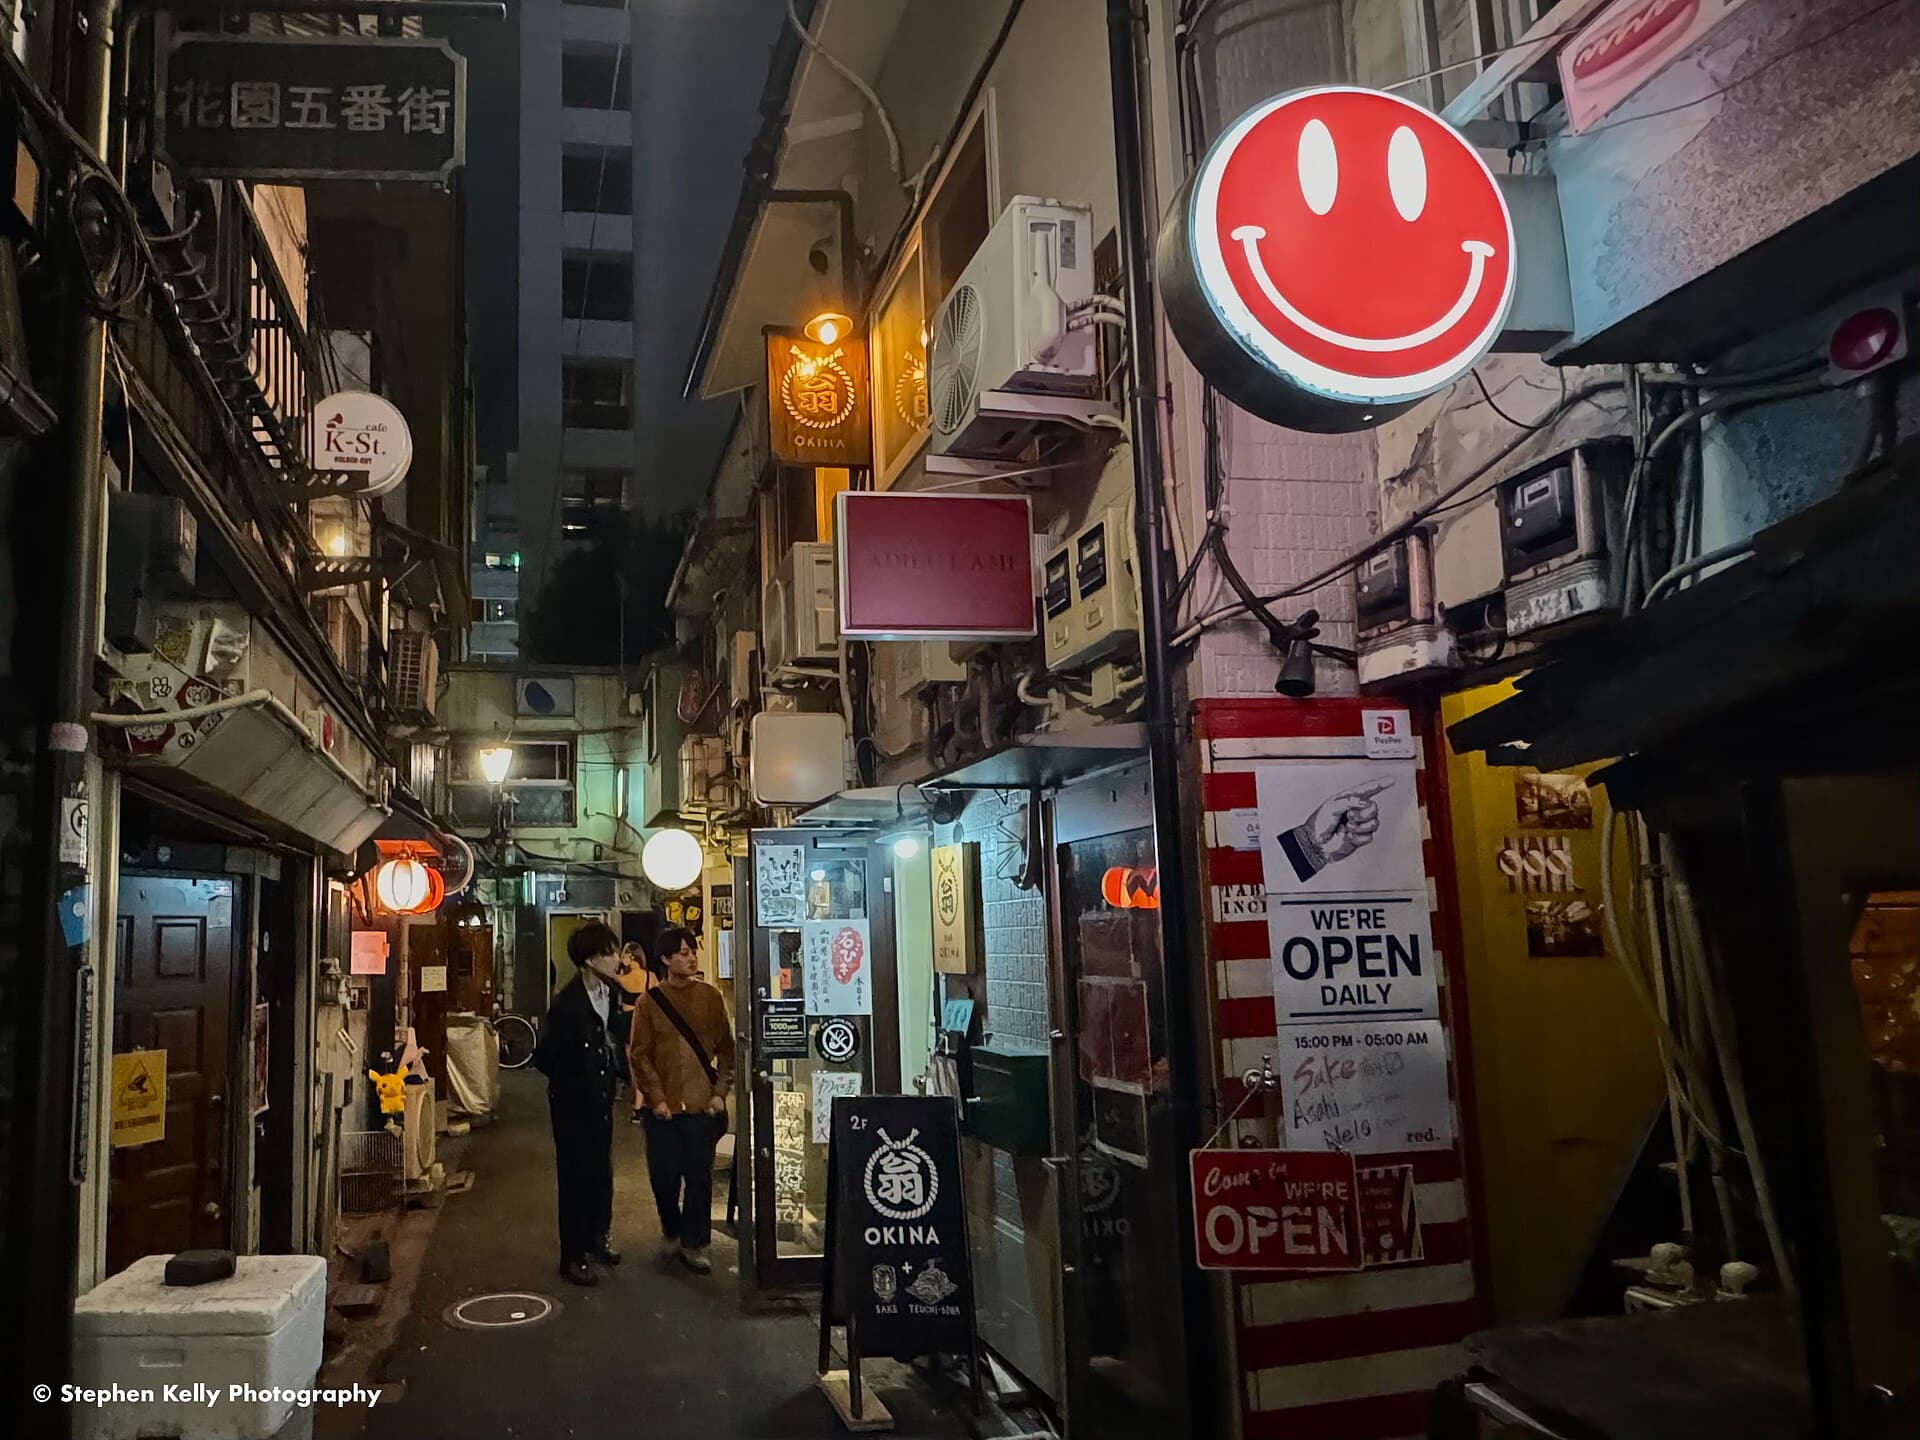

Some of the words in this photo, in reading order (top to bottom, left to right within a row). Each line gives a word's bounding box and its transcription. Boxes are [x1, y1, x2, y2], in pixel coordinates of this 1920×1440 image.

[173, 79, 451, 135] 花園五番街
[324, 430, 386, 455] K-St.
[1311, 909, 1386, 930] WE'RE
[1283, 934, 1421, 980] OPEN
[1321, 983, 1391, 1006] DAILY
[1294, 1035, 1329, 1048] 15:00
[1333, 1035, 1353, 1047] PM
[1365, 1033, 1403, 1047] 05:00
[1407, 1032, 1428, 1045] AM
[850, 1115, 868, 1130] 2F
[1406, 1128, 1440, 1143] red.
[877, 1151, 923, 1205] 翁
[864, 1225, 940, 1245] OKINA
[1205, 1204, 1349, 1255] OPEN
